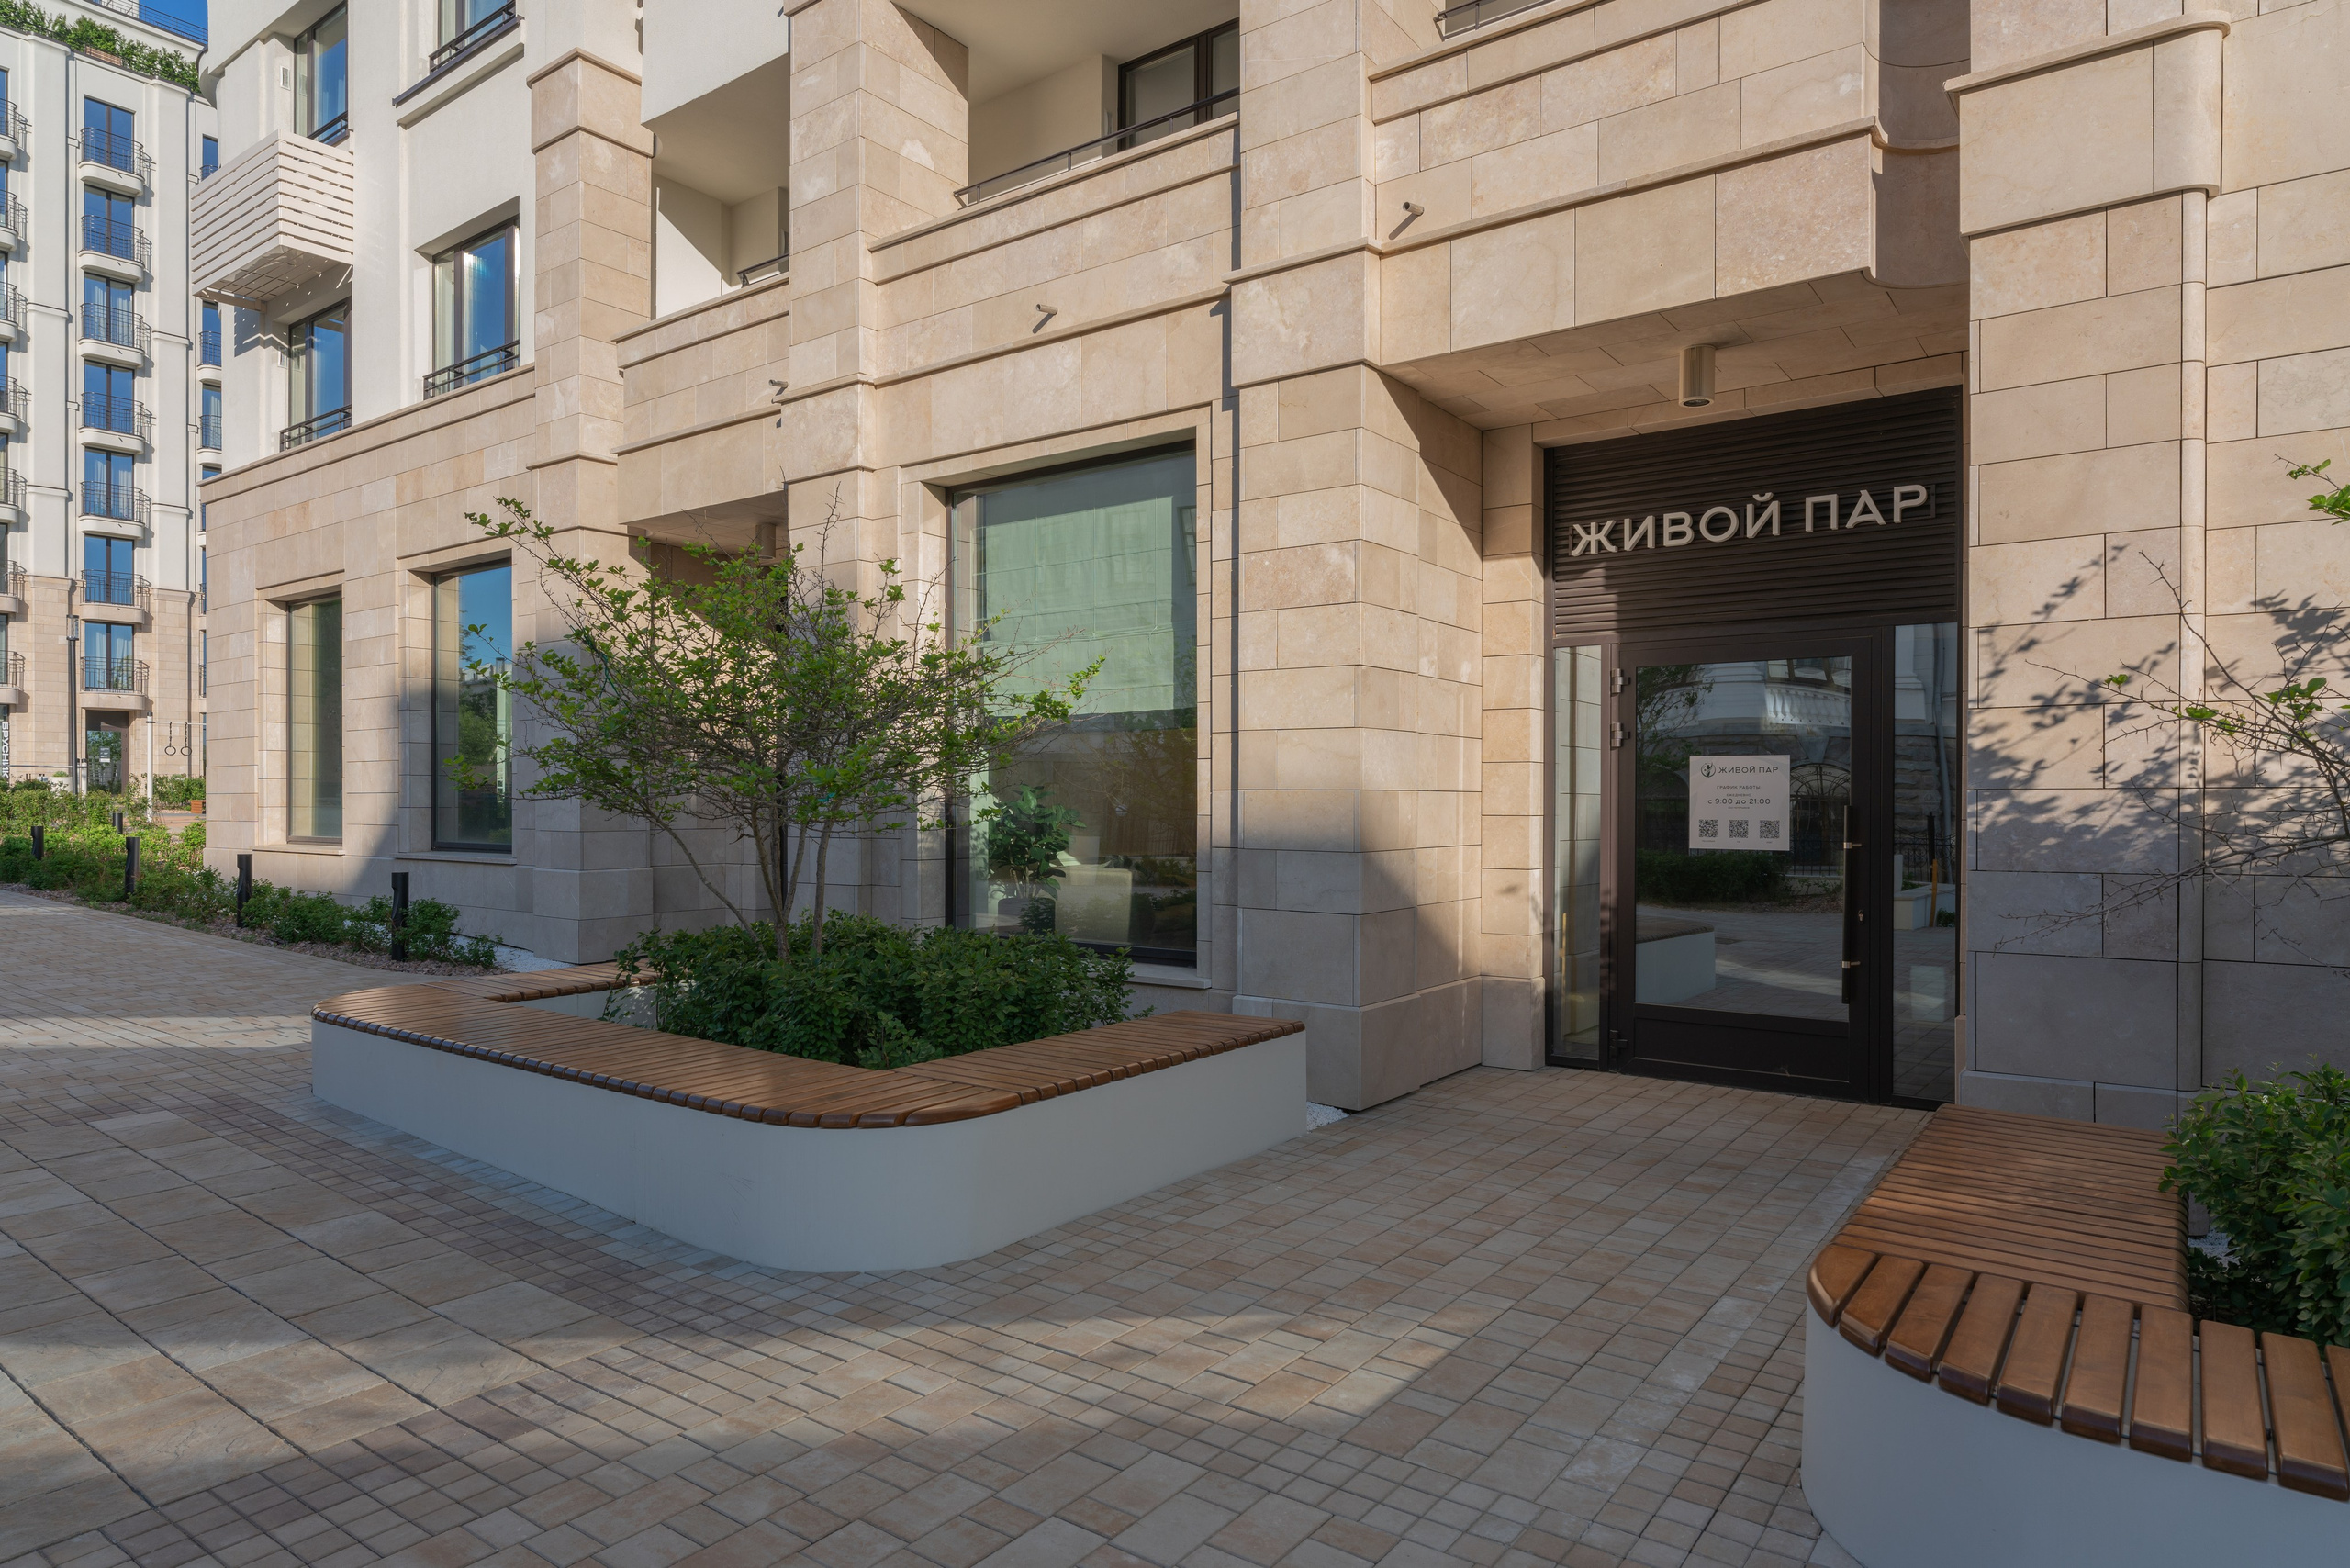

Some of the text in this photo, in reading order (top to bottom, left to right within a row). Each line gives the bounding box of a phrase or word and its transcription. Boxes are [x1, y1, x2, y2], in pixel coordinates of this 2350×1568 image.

[1571, 484, 1928, 557] ЖИВОЙ ПАР
[1718, 765, 1779, 774] ЖИВОЙ ПАР
